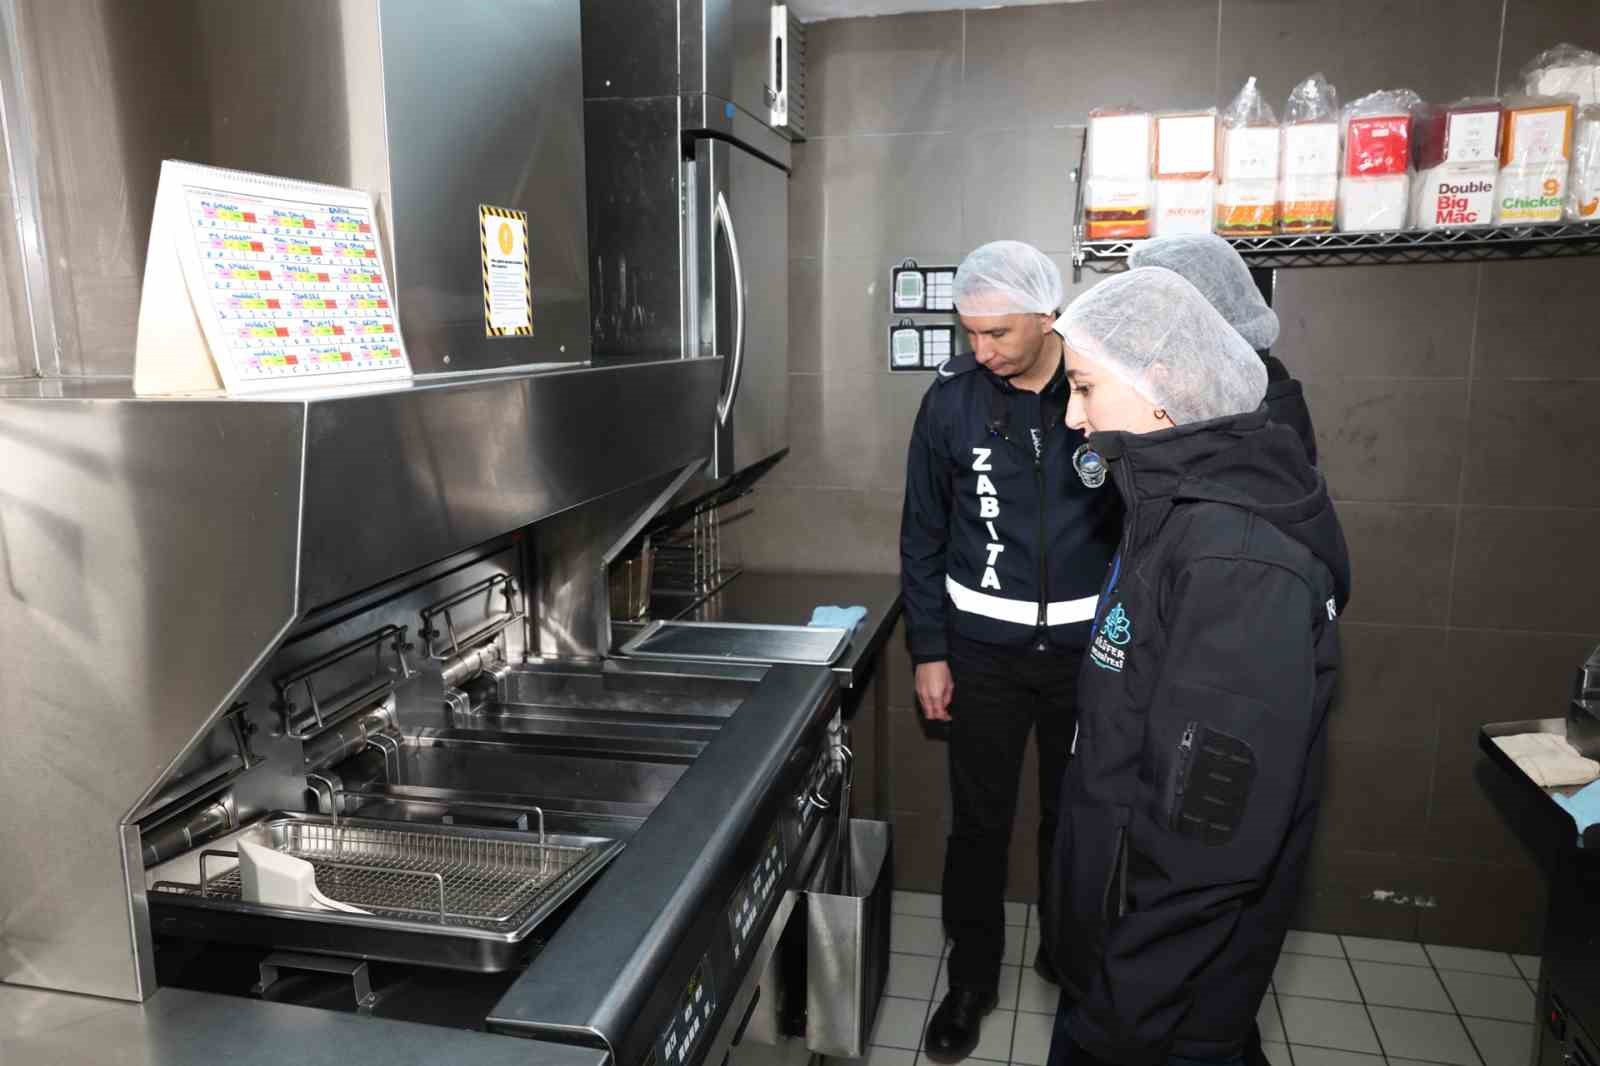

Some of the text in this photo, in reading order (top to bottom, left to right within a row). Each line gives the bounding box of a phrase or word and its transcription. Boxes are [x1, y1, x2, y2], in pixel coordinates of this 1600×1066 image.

[1438, 180, 1493, 195] Double
[1543, 179, 1559, 196] 9
[1436, 195, 1469, 211] Big
[1435, 210, 1478, 225] Mac
[972, 447, 1005, 590] ZABITA
